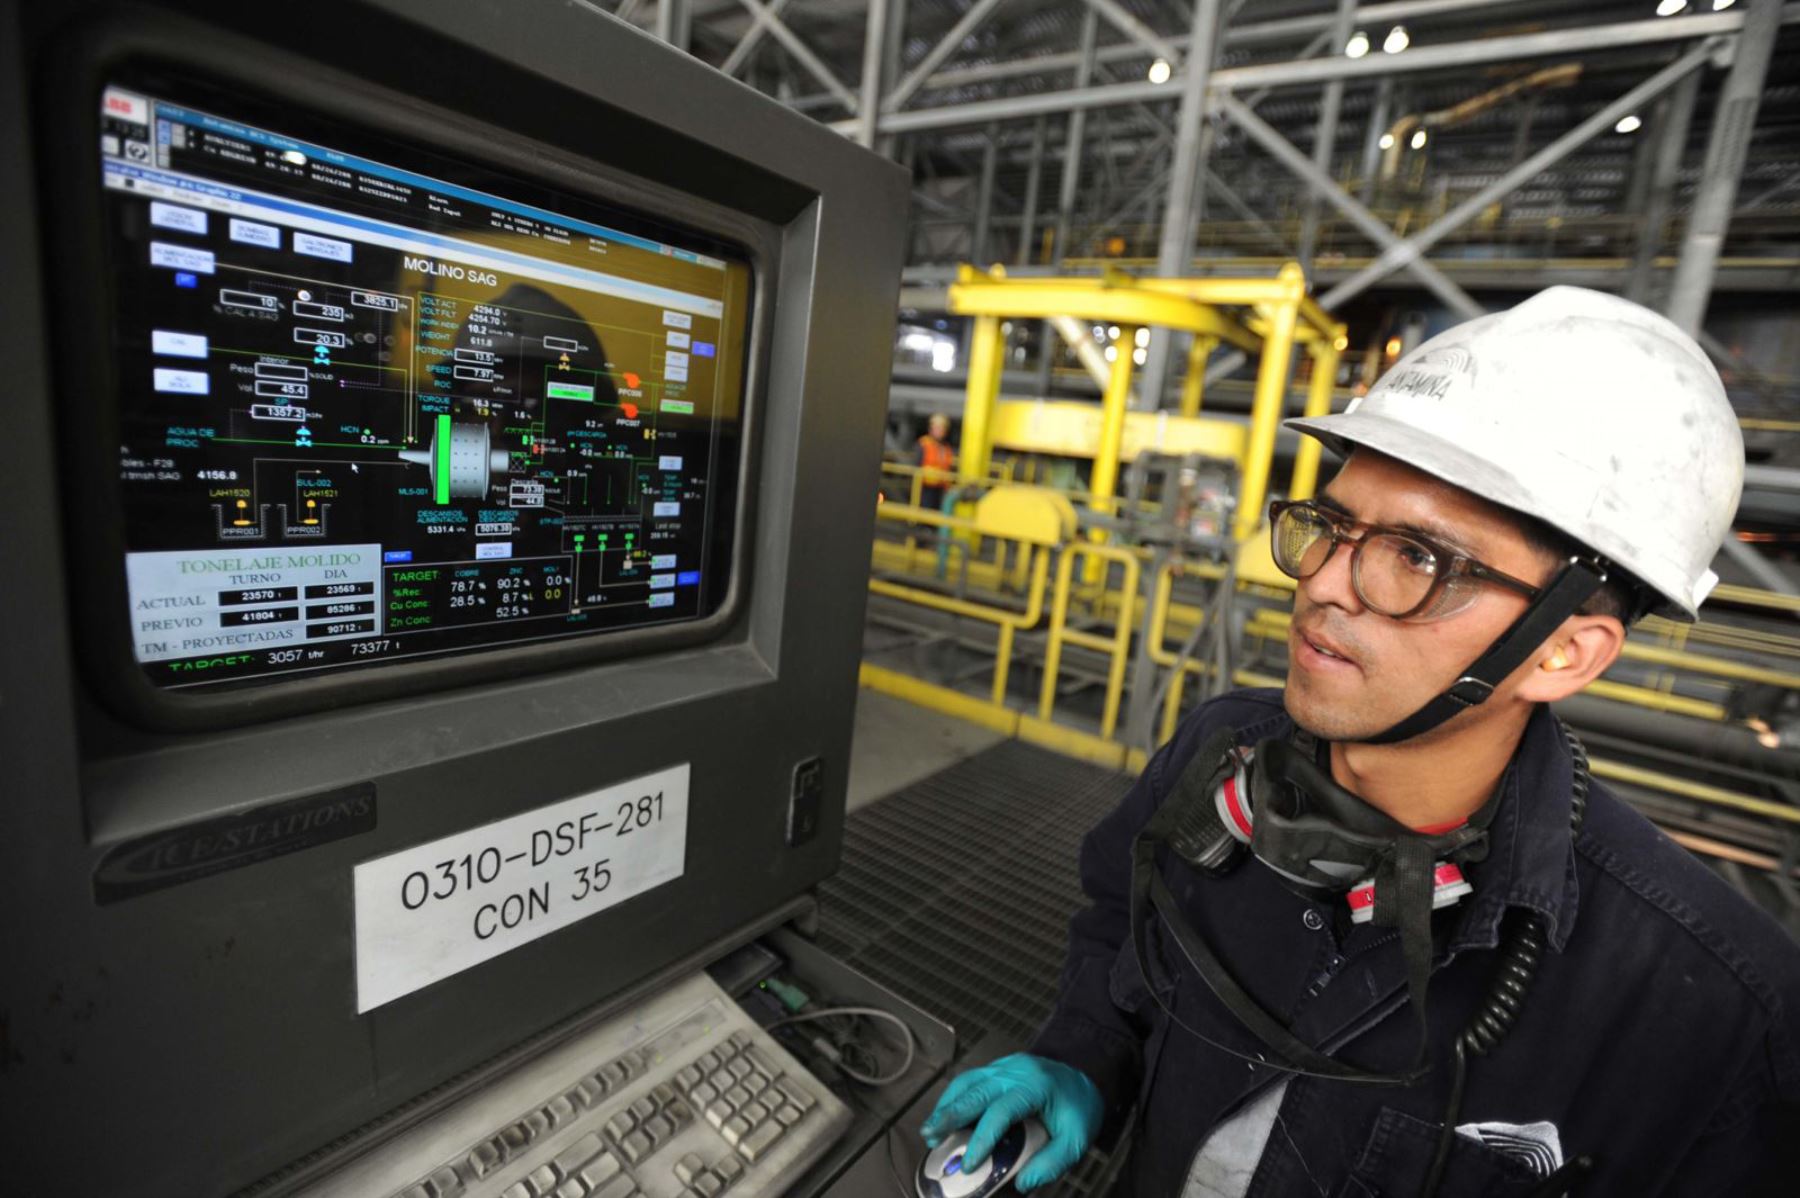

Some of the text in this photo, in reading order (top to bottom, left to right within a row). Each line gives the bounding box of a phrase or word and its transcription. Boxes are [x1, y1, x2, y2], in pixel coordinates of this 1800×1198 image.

[404, 255, 498, 287] MOLINO SAG
[280, 384, 304, 395] 45.4
[167, 426, 198, 437] AGUA
[166, 437, 199, 448] PROC
[197, 470, 238, 480] 4156.8
[177, 555, 284, 575] TONELAJE
[288, 552, 361, 569] MOLIDO
[229, 569, 349, 585] TURNO DIA
[450, 580, 476, 593] 78.7
[497, 577, 520, 590] 90.2
[546, 575, 563, 587] 0.0
[137, 595, 206, 610] ACTUAL
[241, 591, 275, 602] 23570
[326, 585, 356, 595] 23569
[390, 601, 404, 611] Cu
[450, 596, 476, 609] 28.5
[502, 592, 519, 604] 8.7
[545, 588, 561, 601] 0.0
[140, 616, 203, 632] PREVIO
[241, 612, 275, 623] 41804
[496, 606, 520, 619] 52.5
[141, 641, 169, 655] TM
[183, 628, 294, 651] PROYECTADAS
[327, 625, 356, 635] 90712
[268, 648, 303, 665] 3057
[351, 640, 390, 656] 73377
[472, 858, 613, 941] CON 35
